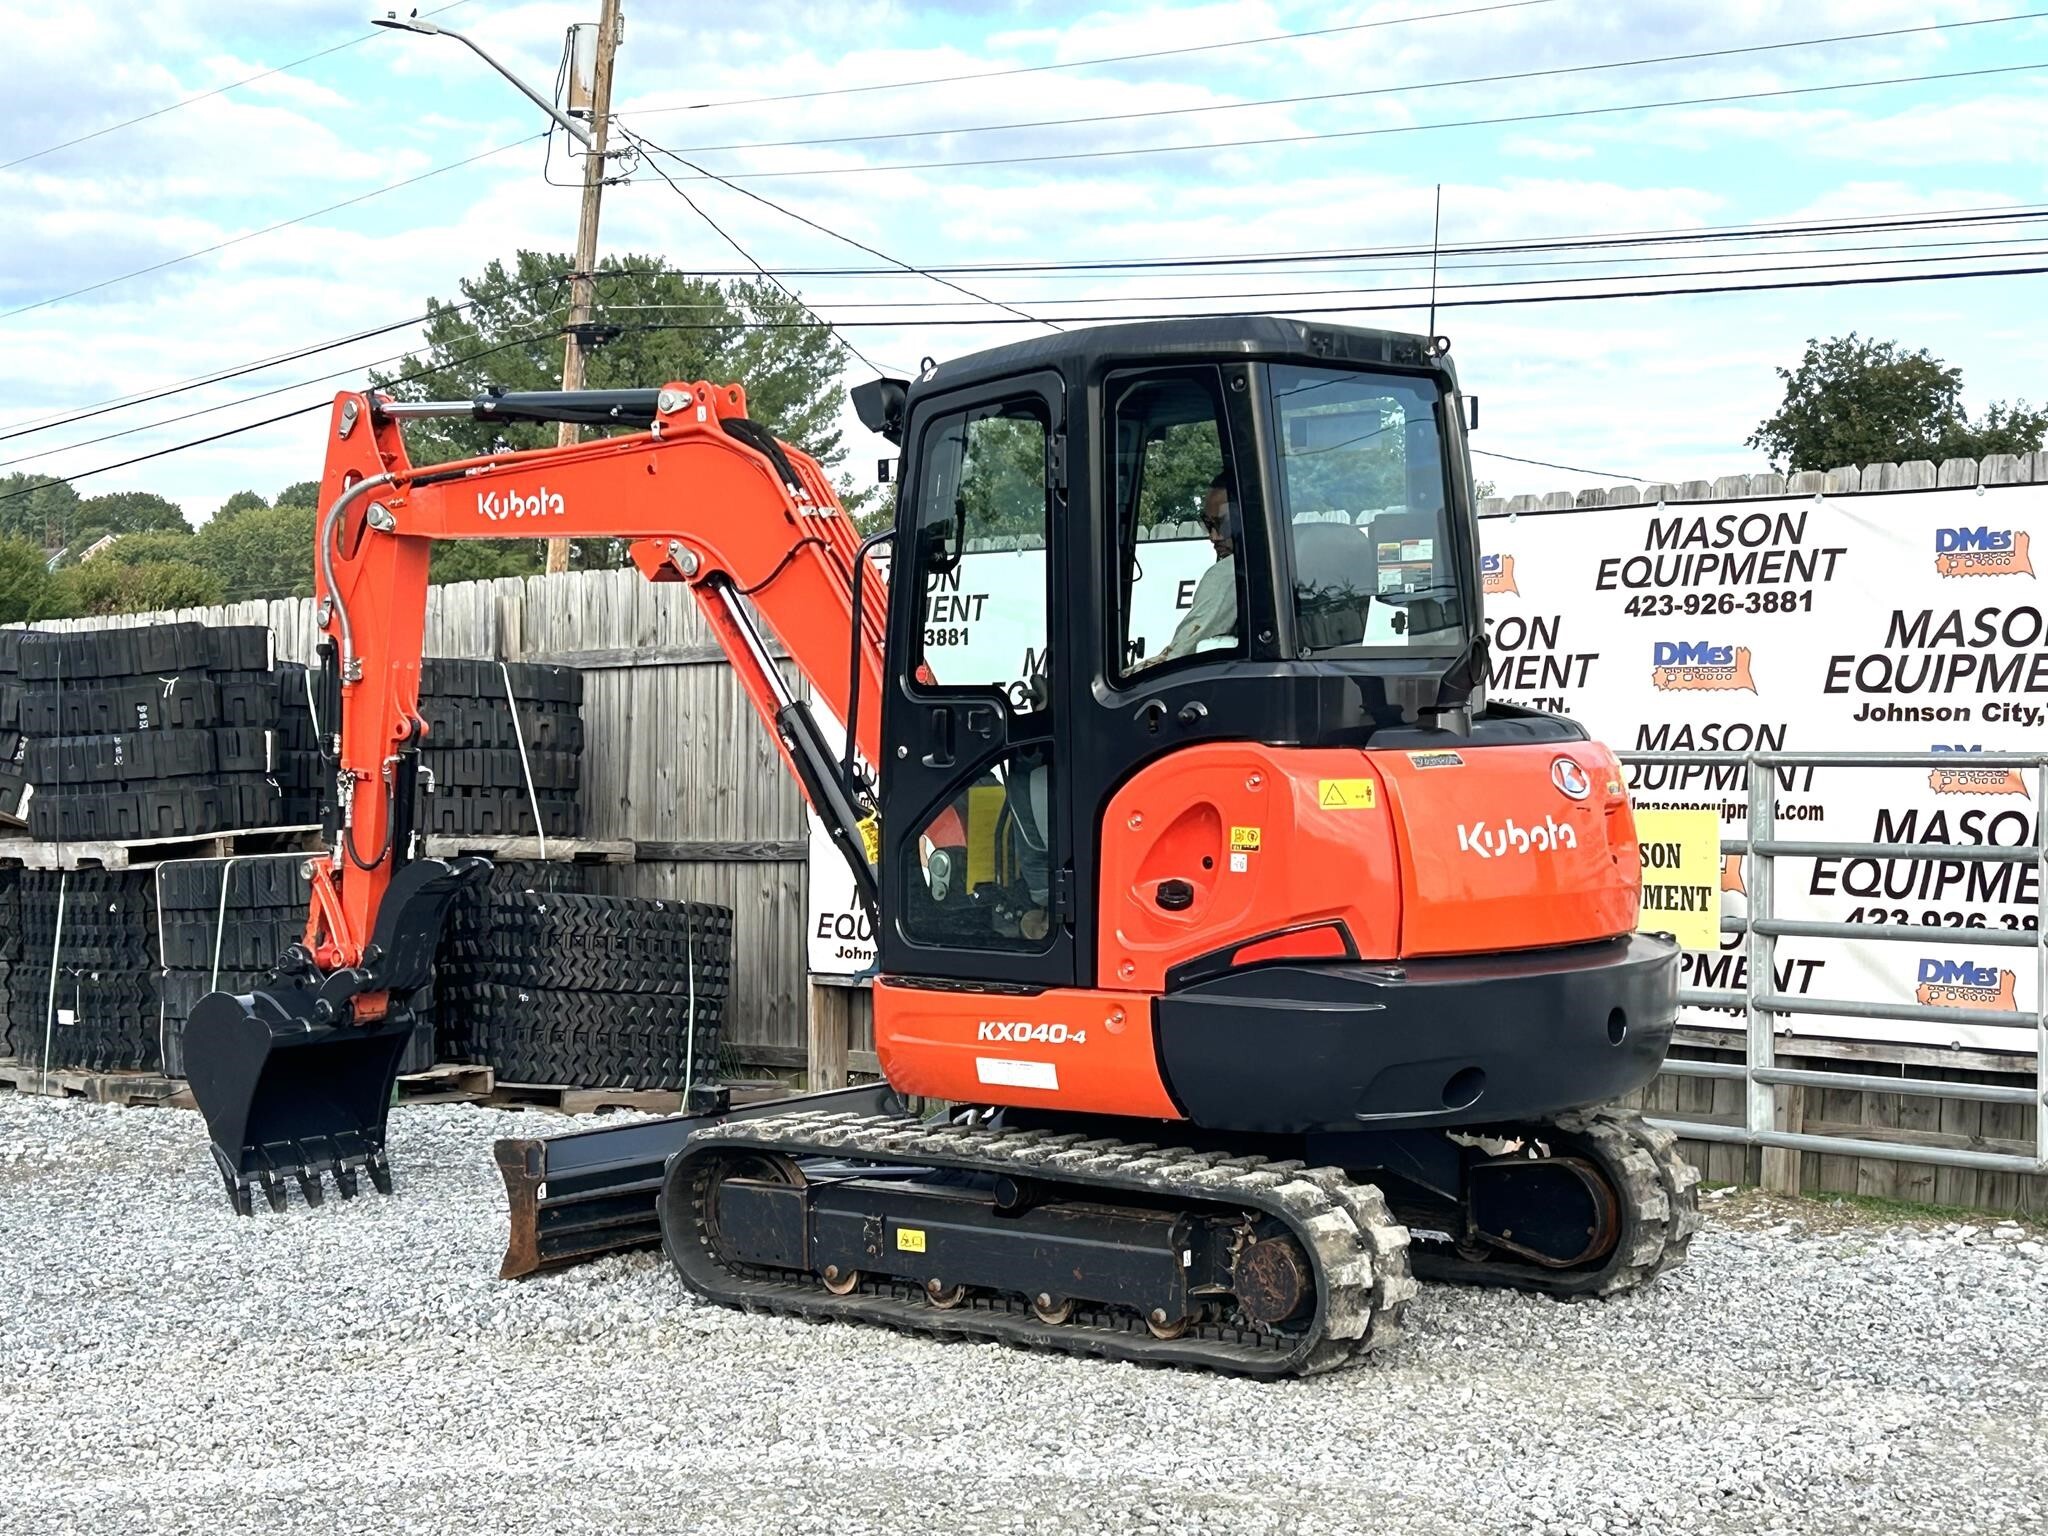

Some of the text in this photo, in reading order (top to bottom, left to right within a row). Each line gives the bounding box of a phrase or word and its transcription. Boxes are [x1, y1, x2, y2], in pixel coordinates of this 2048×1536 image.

[477, 486, 565, 520] Kubota
[1645, 511, 1808, 551] MASON
[1596, 548, 1847, 590] EQUIPMENT
[1624, 590, 1812, 617] 423-926-3881
[1885, 606, 2048, 648] MASO
[1853, 703, 1971, 722] Johnson
[1635, 723, 1787, 751] MASON
[1457, 815, 1577, 858] Kubota
[1873, 809, 2038, 847] MASO
[1643, 885, 1711, 912] MENT
[978, 1021, 1086, 1044] KX040-4
